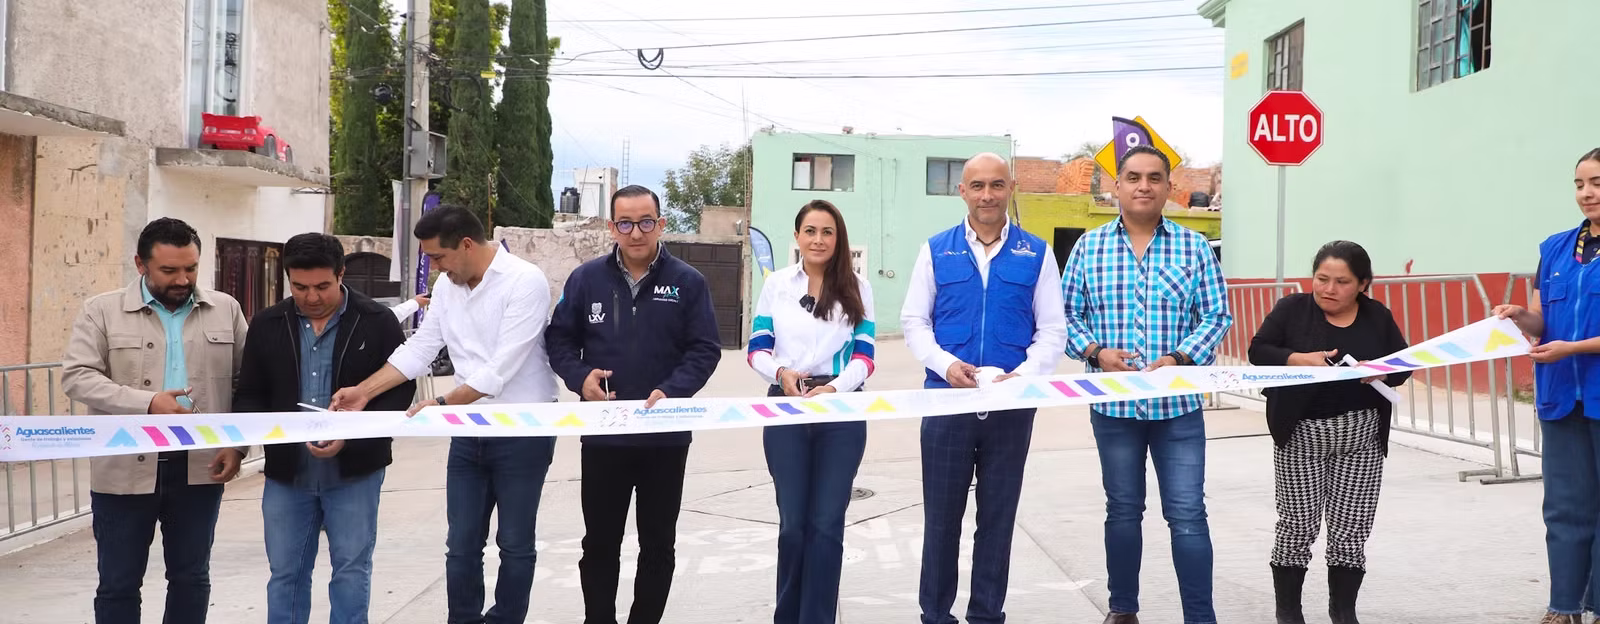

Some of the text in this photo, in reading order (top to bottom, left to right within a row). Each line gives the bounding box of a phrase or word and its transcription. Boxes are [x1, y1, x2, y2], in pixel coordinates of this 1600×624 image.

[1253, 114, 1318, 142] ALTO
[653, 285, 680, 296] MAX
[588, 313, 606, 322] LXV
[633, 406, 707, 416] Aguascalientes
[16, 426, 96, 438] Aguascalientes
